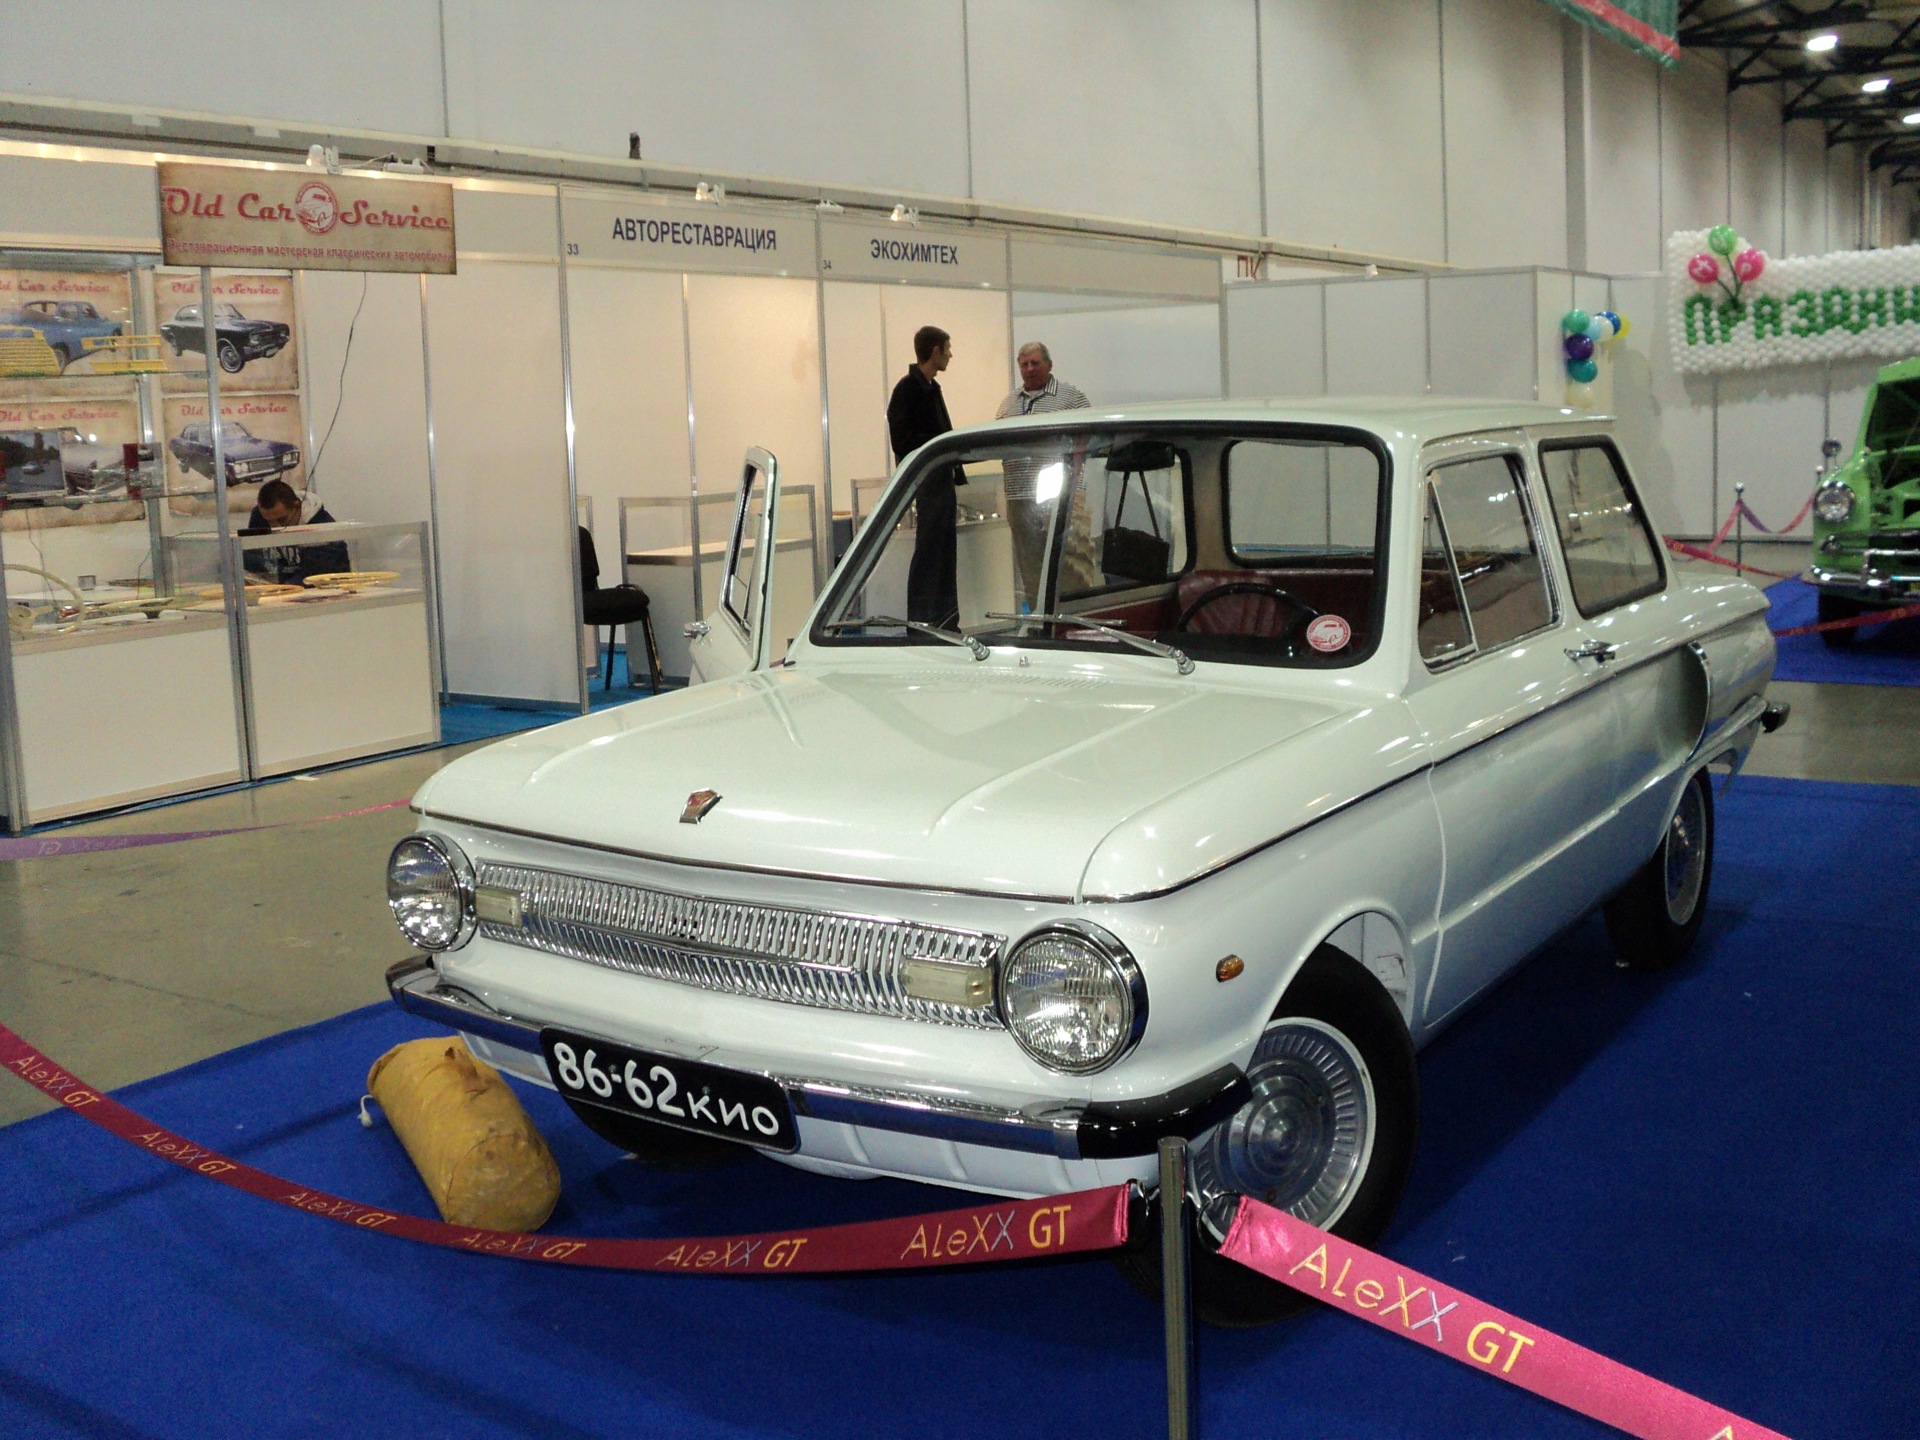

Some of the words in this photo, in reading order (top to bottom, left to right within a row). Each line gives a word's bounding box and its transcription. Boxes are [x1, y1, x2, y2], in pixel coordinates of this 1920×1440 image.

[162, 186, 224, 217] Old
[237, 192, 295, 221] Car
[339, 199, 452, 230] Service
[612, 217, 777, 253] АВТОРЕСТАВРАЦИЯ
[567, 243, 579, 255] 33
[870, 238, 959, 265] ЭКОХИМТЕХ
[229, 283, 280, 295] Service
[237, 402, 288, 415] Service
[63, 1090, 99, 1108] GT
[198, 1159, 237, 1175] GT
[355, 1212, 398, 1228] GT
[1028, 1204, 1072, 1248] GT
[541, 1241, 587, 1260] GT
[763, 1238, 808, 1269] GT
[1466, 1321, 1535, 1374] GT
